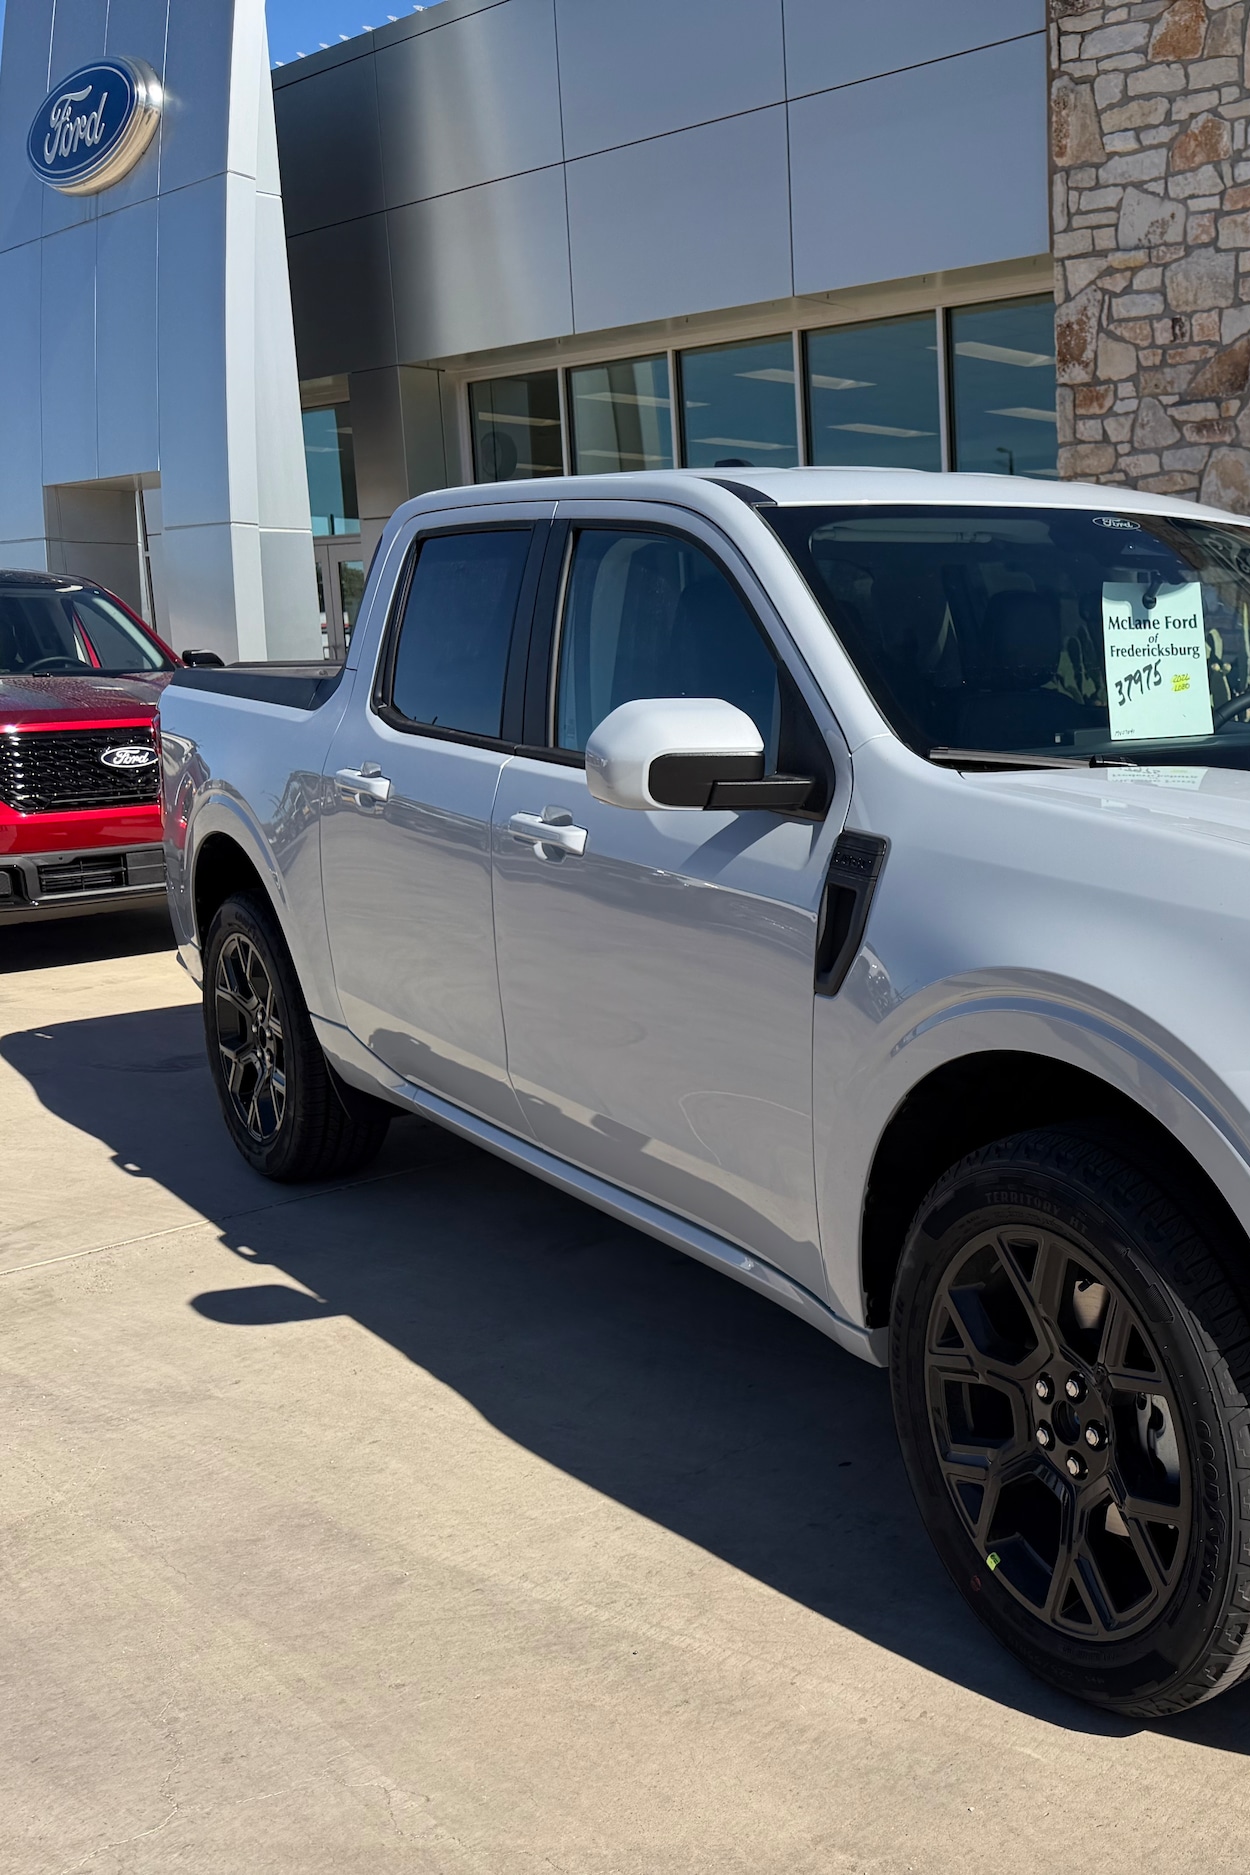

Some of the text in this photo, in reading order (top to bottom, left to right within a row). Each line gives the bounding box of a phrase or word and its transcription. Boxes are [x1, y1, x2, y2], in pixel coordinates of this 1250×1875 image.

[44, 85, 108, 164] Ford
[1108, 614, 1198, 630] McLane Ford
[1148, 633, 1160, 643] of
[1110, 643, 1200, 659] Fredericksburg
[1114, 658, 1162, 707] 37975
[113, 750, 149, 764] Ford
[985, 1191, 1061, 1216] TERRITORY
